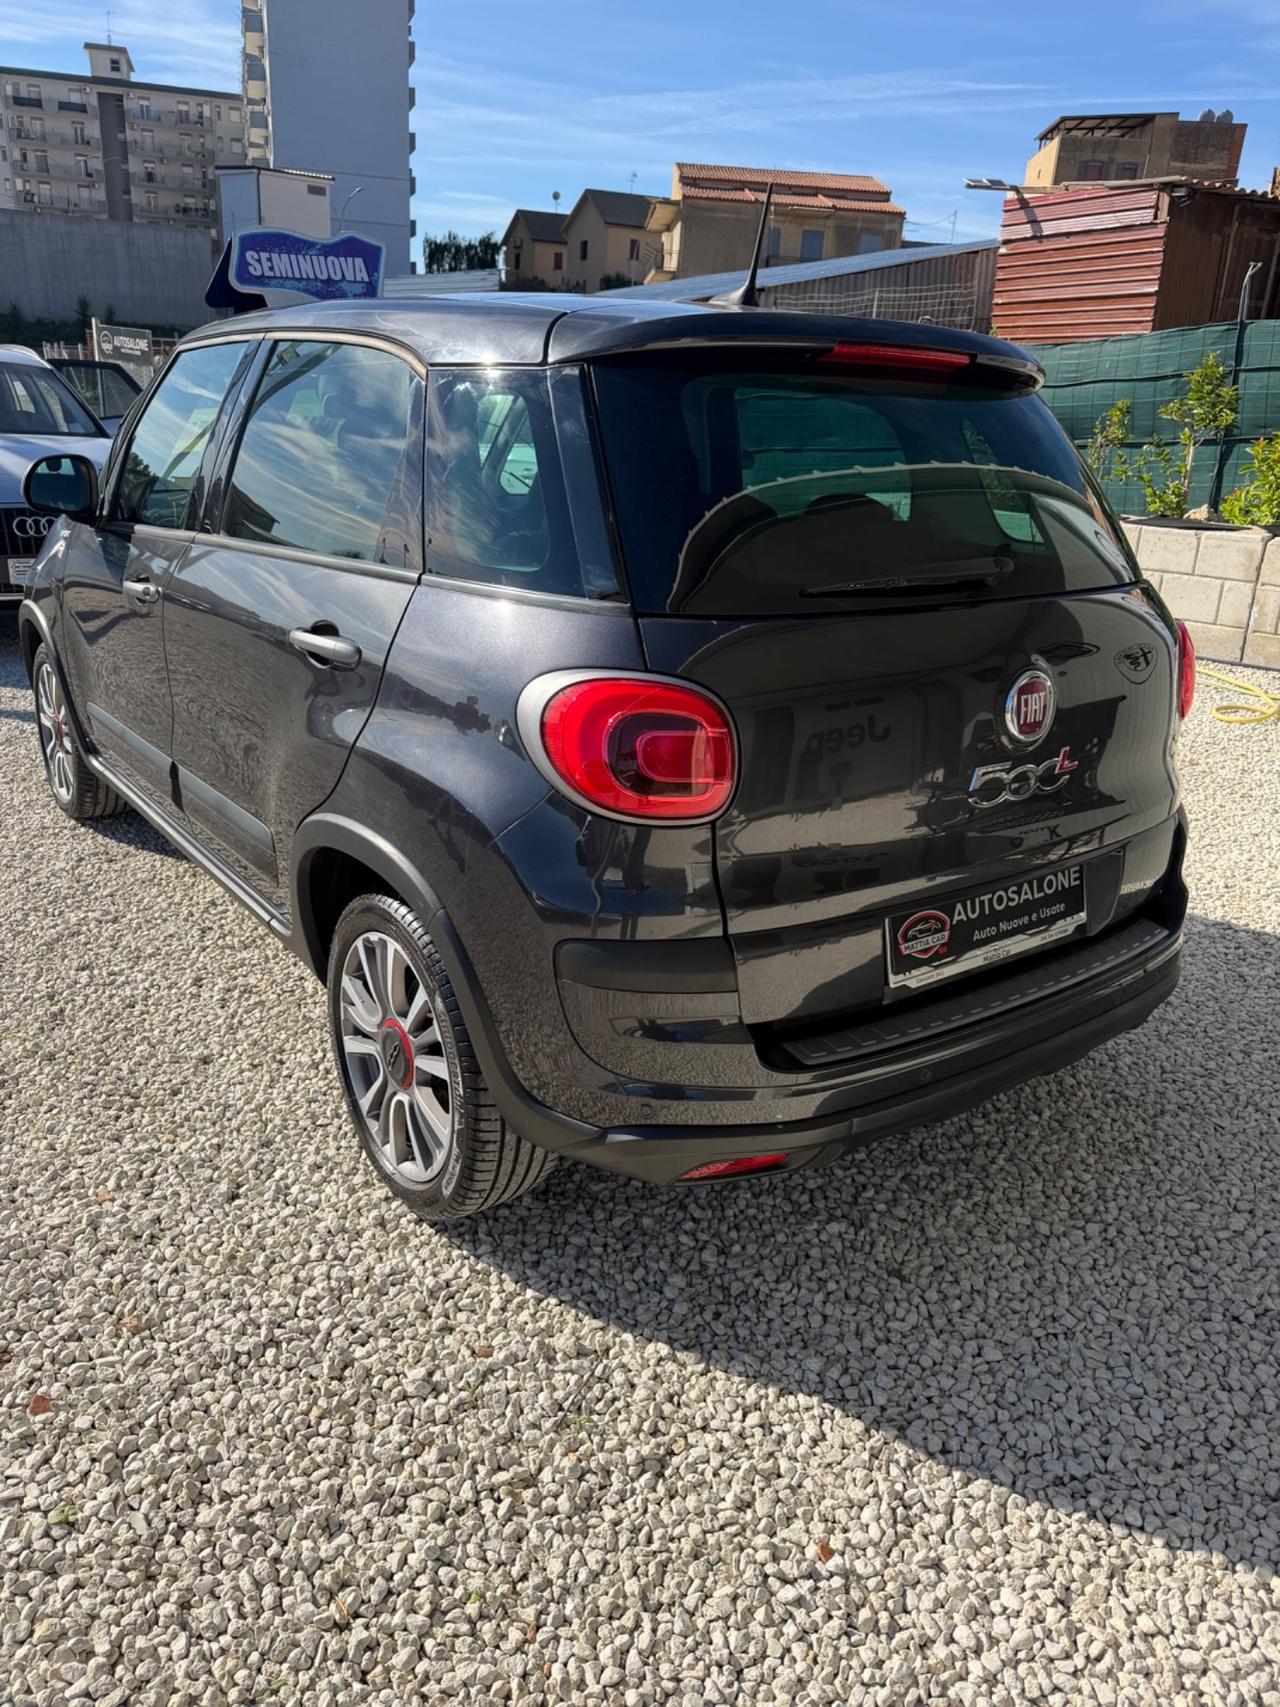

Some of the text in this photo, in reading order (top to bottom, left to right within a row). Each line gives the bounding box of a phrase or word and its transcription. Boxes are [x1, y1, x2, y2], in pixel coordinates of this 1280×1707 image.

[245, 250, 370, 282] SEMINUOVA
[114, 335, 149, 351] AUTOSALONE
[1020, 692, 1046, 724] FIAT
[952, 866, 1080, 925] AUTOSALONE
[973, 903, 1066, 942] Auto Nuove e Usate
[904, 933, 946, 953] MATTIA CAR
